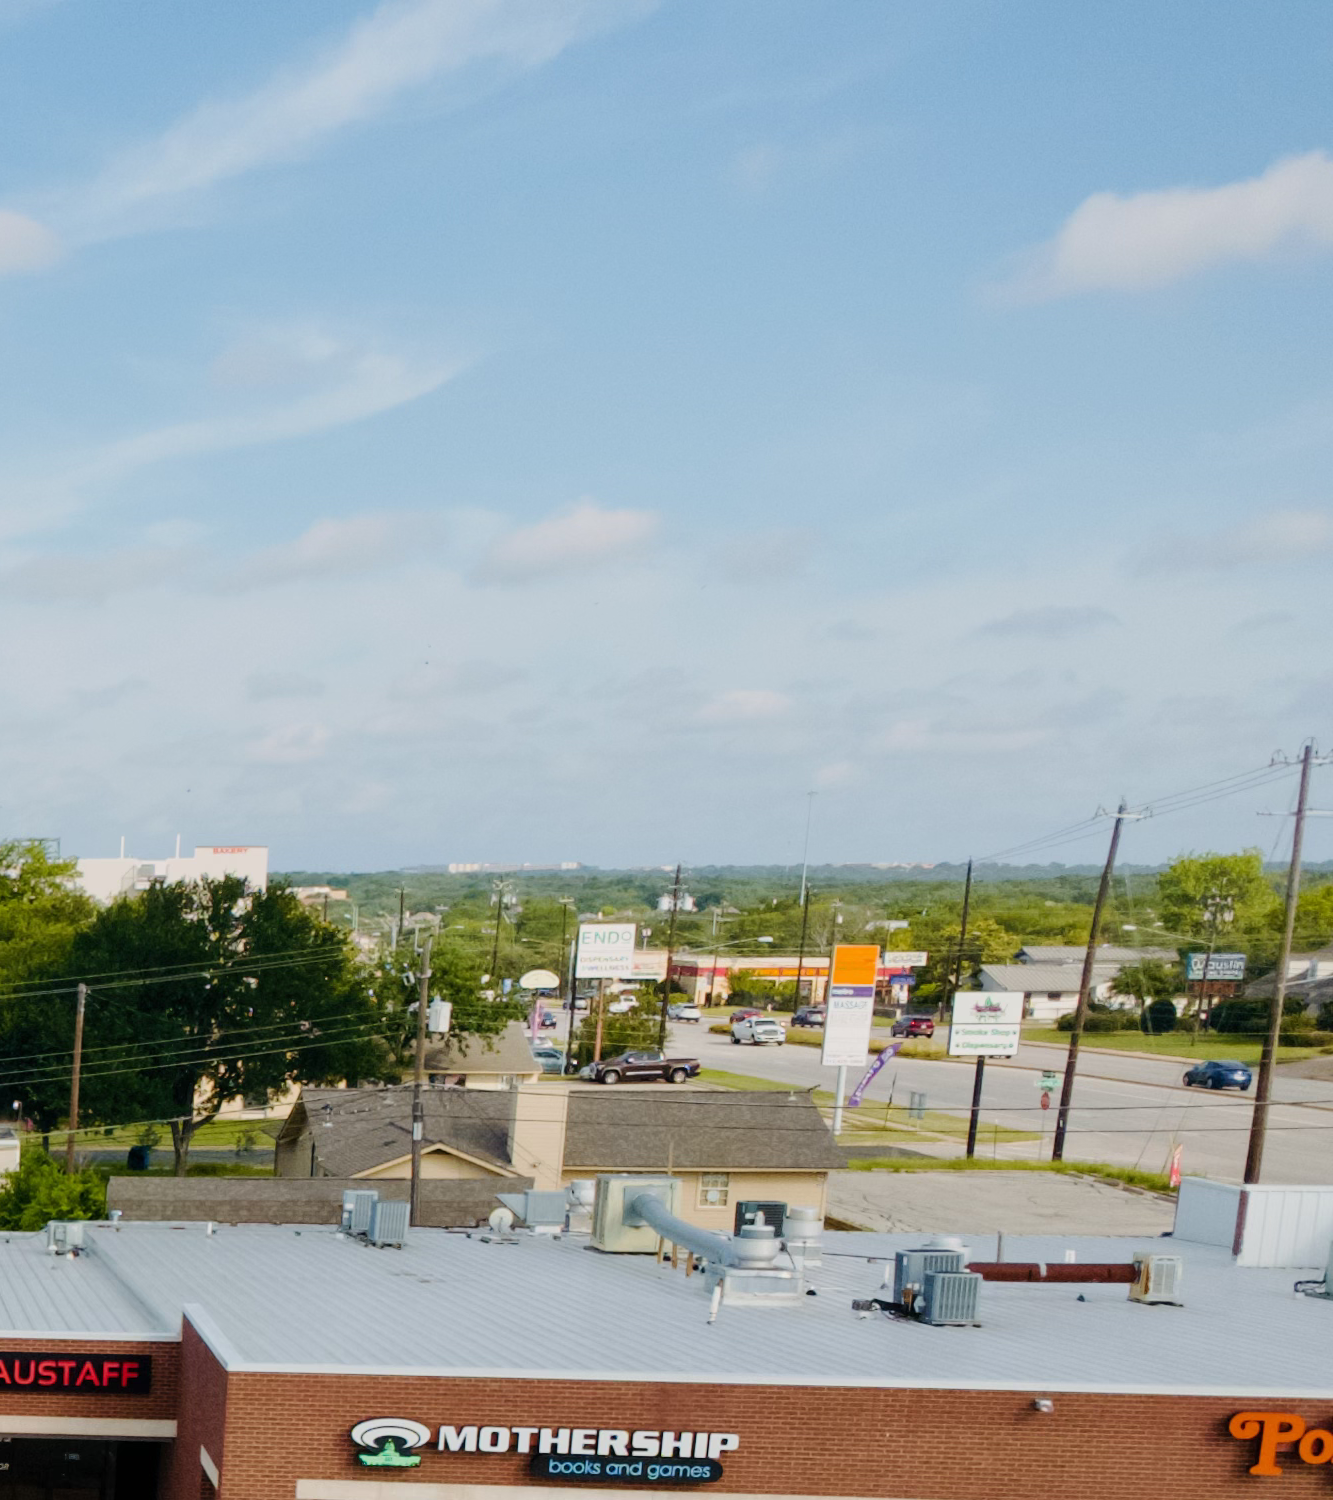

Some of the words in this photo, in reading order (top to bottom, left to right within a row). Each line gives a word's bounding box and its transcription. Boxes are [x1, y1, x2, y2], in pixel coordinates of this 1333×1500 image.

[581, 931, 632, 944] ENDO
[437, 1425, 740, 1459] MOTHERSHIP
[1228, 1412, 1333, 1476] Po
[549, 1459, 601, 1475] books
[606, 1460, 642, 1477] and
[647, 1463, 711, 1480] games
